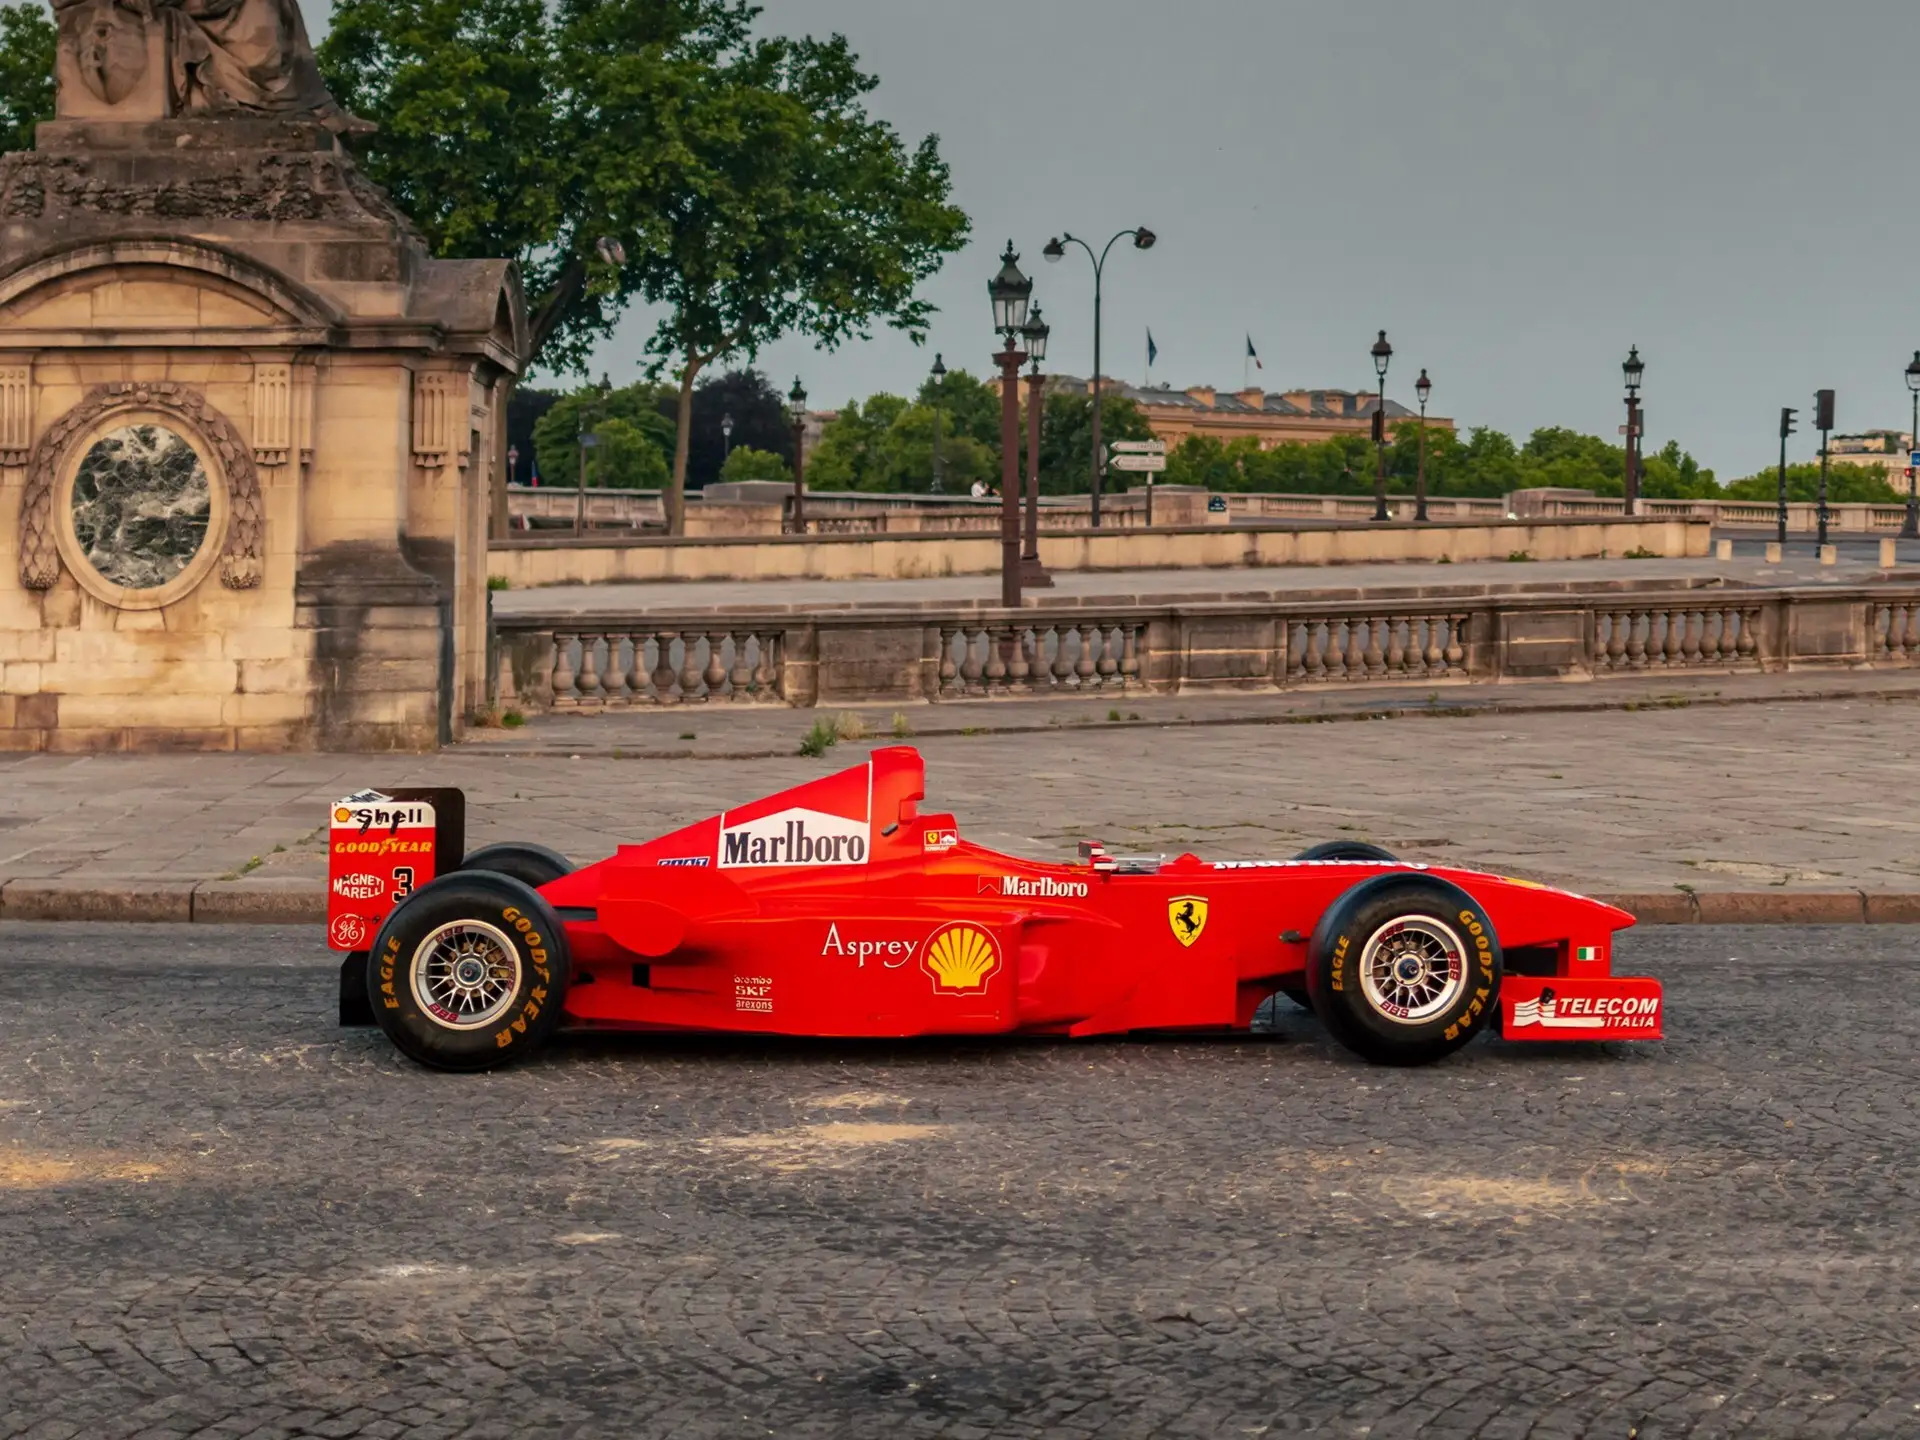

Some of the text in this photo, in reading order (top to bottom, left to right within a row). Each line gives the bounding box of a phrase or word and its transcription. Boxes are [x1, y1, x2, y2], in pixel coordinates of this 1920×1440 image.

[357, 808, 422, 823] Shell
[722, 820, 865, 865] Marlboro
[333, 882, 384, 899] MARELLI
[392, 866, 414, 903] 3
[1002, 876, 1088, 898] Marlboro
[821, 922, 918, 968] Asprey
[379, 935, 401, 1009] EAGLE
[1331, 934, 1349, 992] EAGLE
[735, 985, 772, 996] SKF
[736, 999, 773, 1010] arexons
[1380, 1000, 1410, 1019] BBS
[1559, 998, 1659, 1015] TELECOM
[1606, 1016, 1655, 1027] ITALIA
